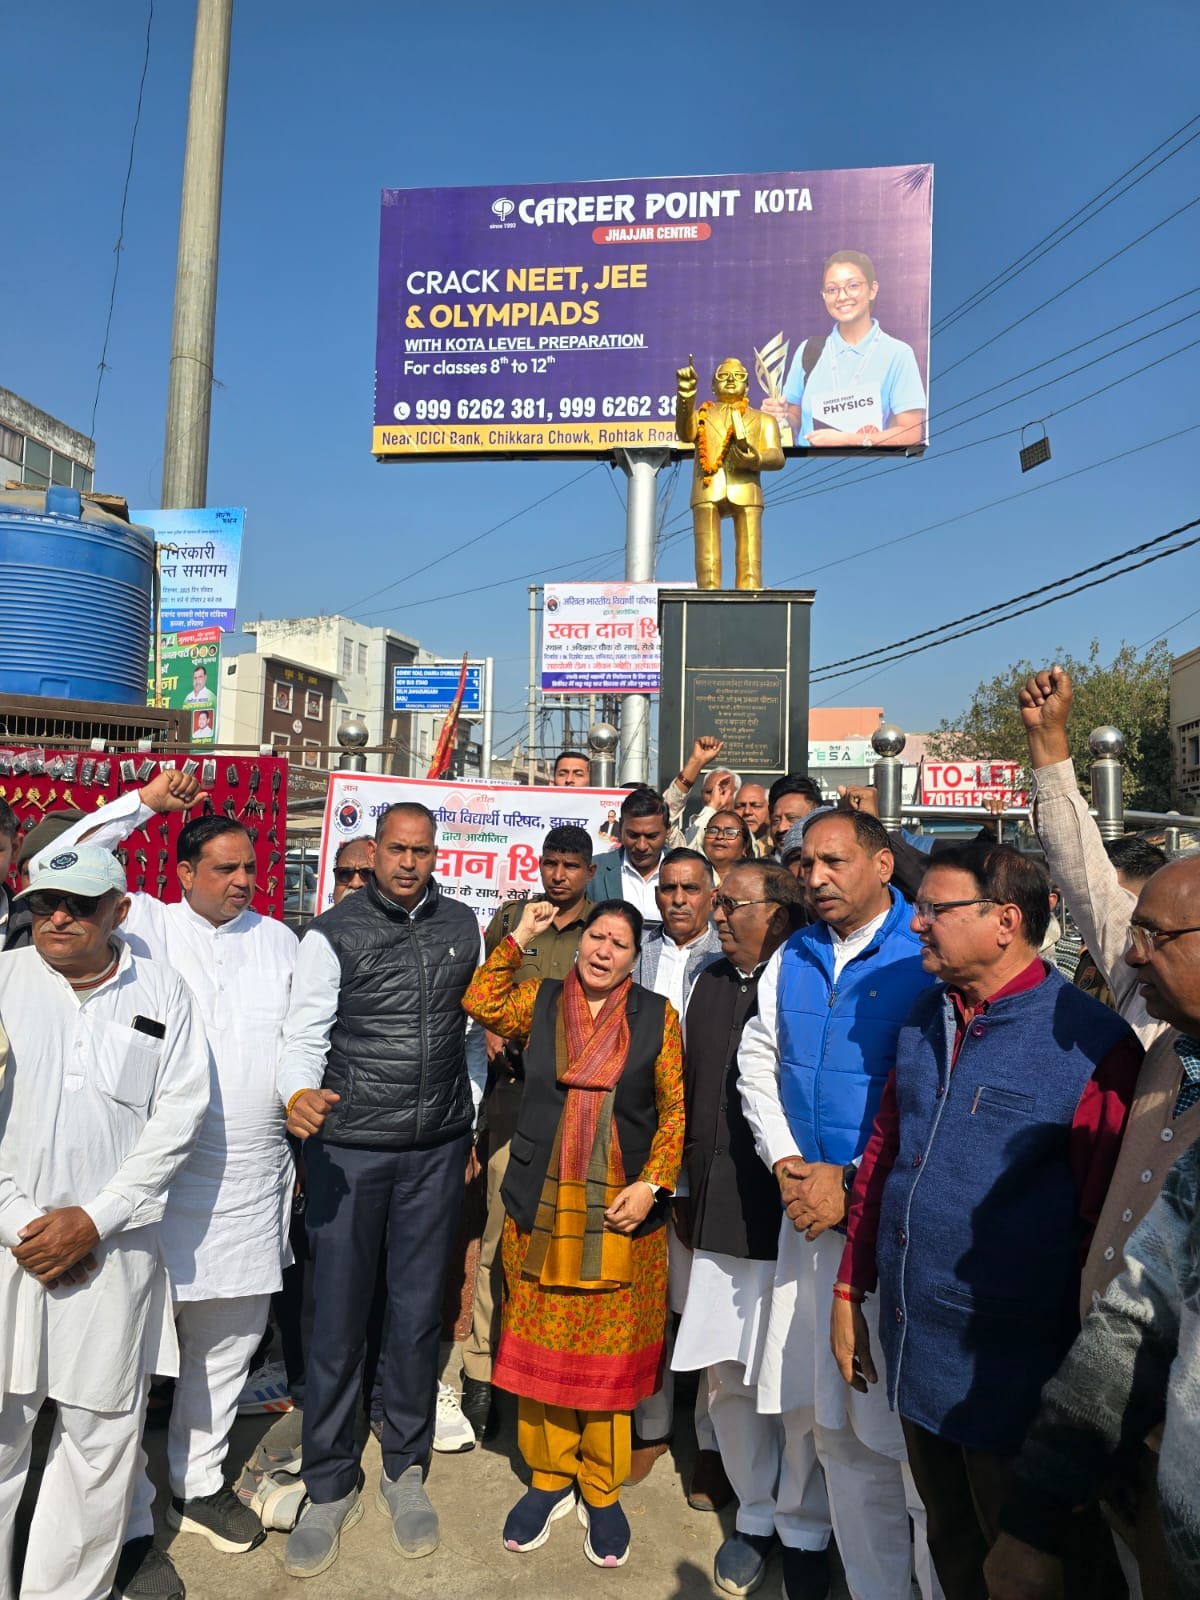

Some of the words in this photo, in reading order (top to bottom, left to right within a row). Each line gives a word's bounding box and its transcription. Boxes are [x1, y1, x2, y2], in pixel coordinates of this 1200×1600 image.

[519, 194, 636, 227] CAREER
[645, 190, 741, 219] POINT
[754, 188, 813, 213] KOTA
[605, 227, 654, 241] JHAJJAR
[657, 226, 698, 239] CENTRE
[406, 269, 500, 295] CRACK
[506, 266, 588, 294] NEET,
[594, 264, 648, 289] JEE
[405, 305, 425, 329] &
[429, 300, 600, 328] OLYMPIADS
[404, 338, 441, 352] WITH
[445, 337, 485, 351] KOTA
[489, 336, 535, 350] LEVEL
[539, 334, 644, 349] PREPARATION
[404, 360, 430, 375] For
[433, 359, 487, 374] classes
[511, 358, 528, 373] to
[415, 400, 451, 420] 999
[457, 399, 505, 419] 6262
[511, 398, 553, 422] 381,
[559, 397, 596, 418] 999
[602, 396, 651, 417] 6262
[823, 397, 874, 415] PHYSICS
[382, 431, 411, 445] Near
[416, 430, 445, 444] ICICI
[450, 430, 484, 446] Bank,
[488, 430, 543, 445] Chikkara
[549, 429, 594, 446] Chowk,
[599, 428, 643, 443] Rohtak
[182, 564, 228, 578] समागम
[547, 622, 591, 639] रक्त
[595, 622, 635, 639] दान
[927, 765, 1020, 788] TO-LET
[460, 808, 501, 826] विद्यार्थी
[442, 831, 461, 842] द्वारा
[464, 832, 508, 844] आयोजित
[460, 885, 472, 896] के
